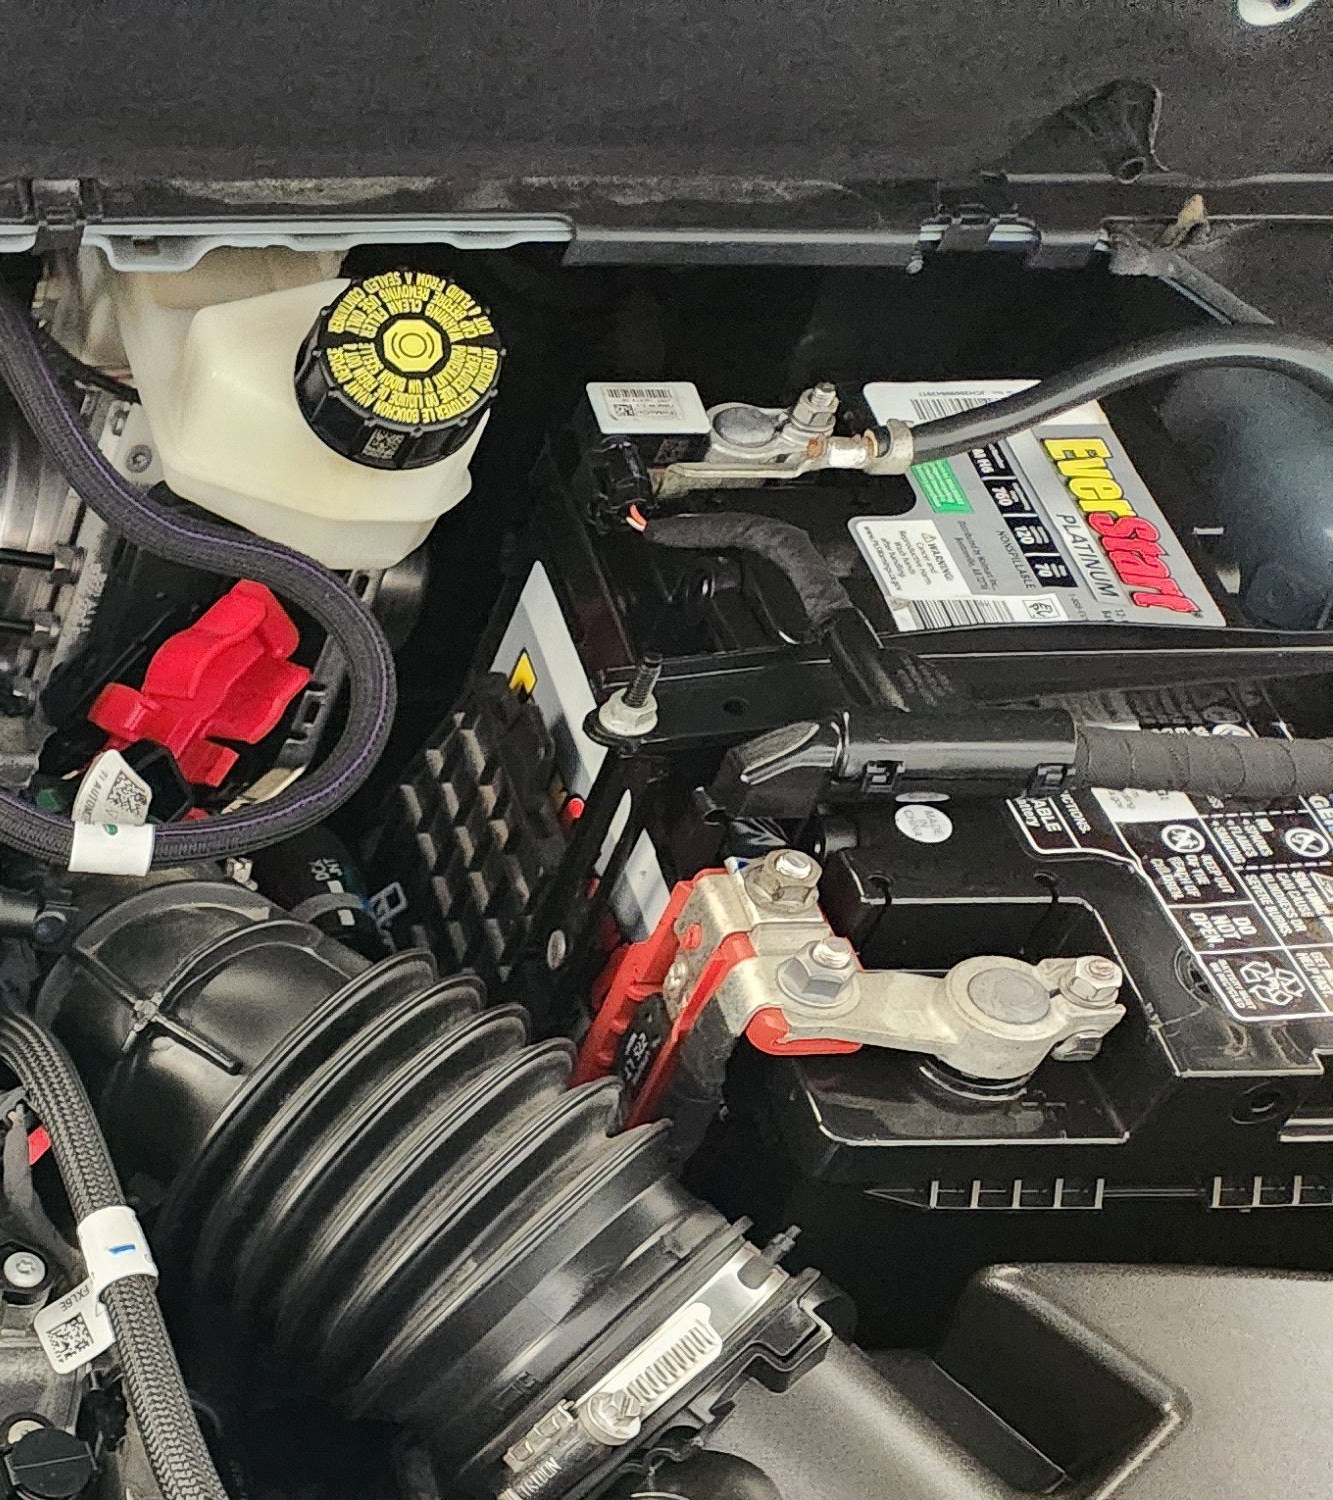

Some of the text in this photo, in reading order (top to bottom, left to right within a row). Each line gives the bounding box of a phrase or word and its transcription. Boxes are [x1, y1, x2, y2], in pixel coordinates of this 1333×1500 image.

[363, 271, 403, 294] SEALED
[404, 271, 413, 285] A
[416, 272, 446, 291] FROM
[386, 298, 423, 316] CLEAN
[446, 284, 476, 309] FLUID
[327, 286, 366, 334] CONTAINER
[344, 284, 479, 339] CAP BEFORE REMOVING USE ONLY
[425, 302, 465, 343] WARNING
[473, 315, 494, 335] DOT
[471, 347, 498, 394] ATTENTION
[372, 400, 420, 424] BOUCHON
[421, 407, 437, 424] LE
[1042, 437, 1202, 614] EverStart
[996, 529, 1036, 590] NONSPILLABLE
[1056, 513, 1120, 598] PLATINUM
[1245, 874, 1274, 908] SEVERE
[1275, 872, 1316, 918] CAN CAUSE
[1210, 914, 1241, 940] NOT
[1233, 916, 1257, 935] DO
[59, 1285, 91, 1312] FXL6E
